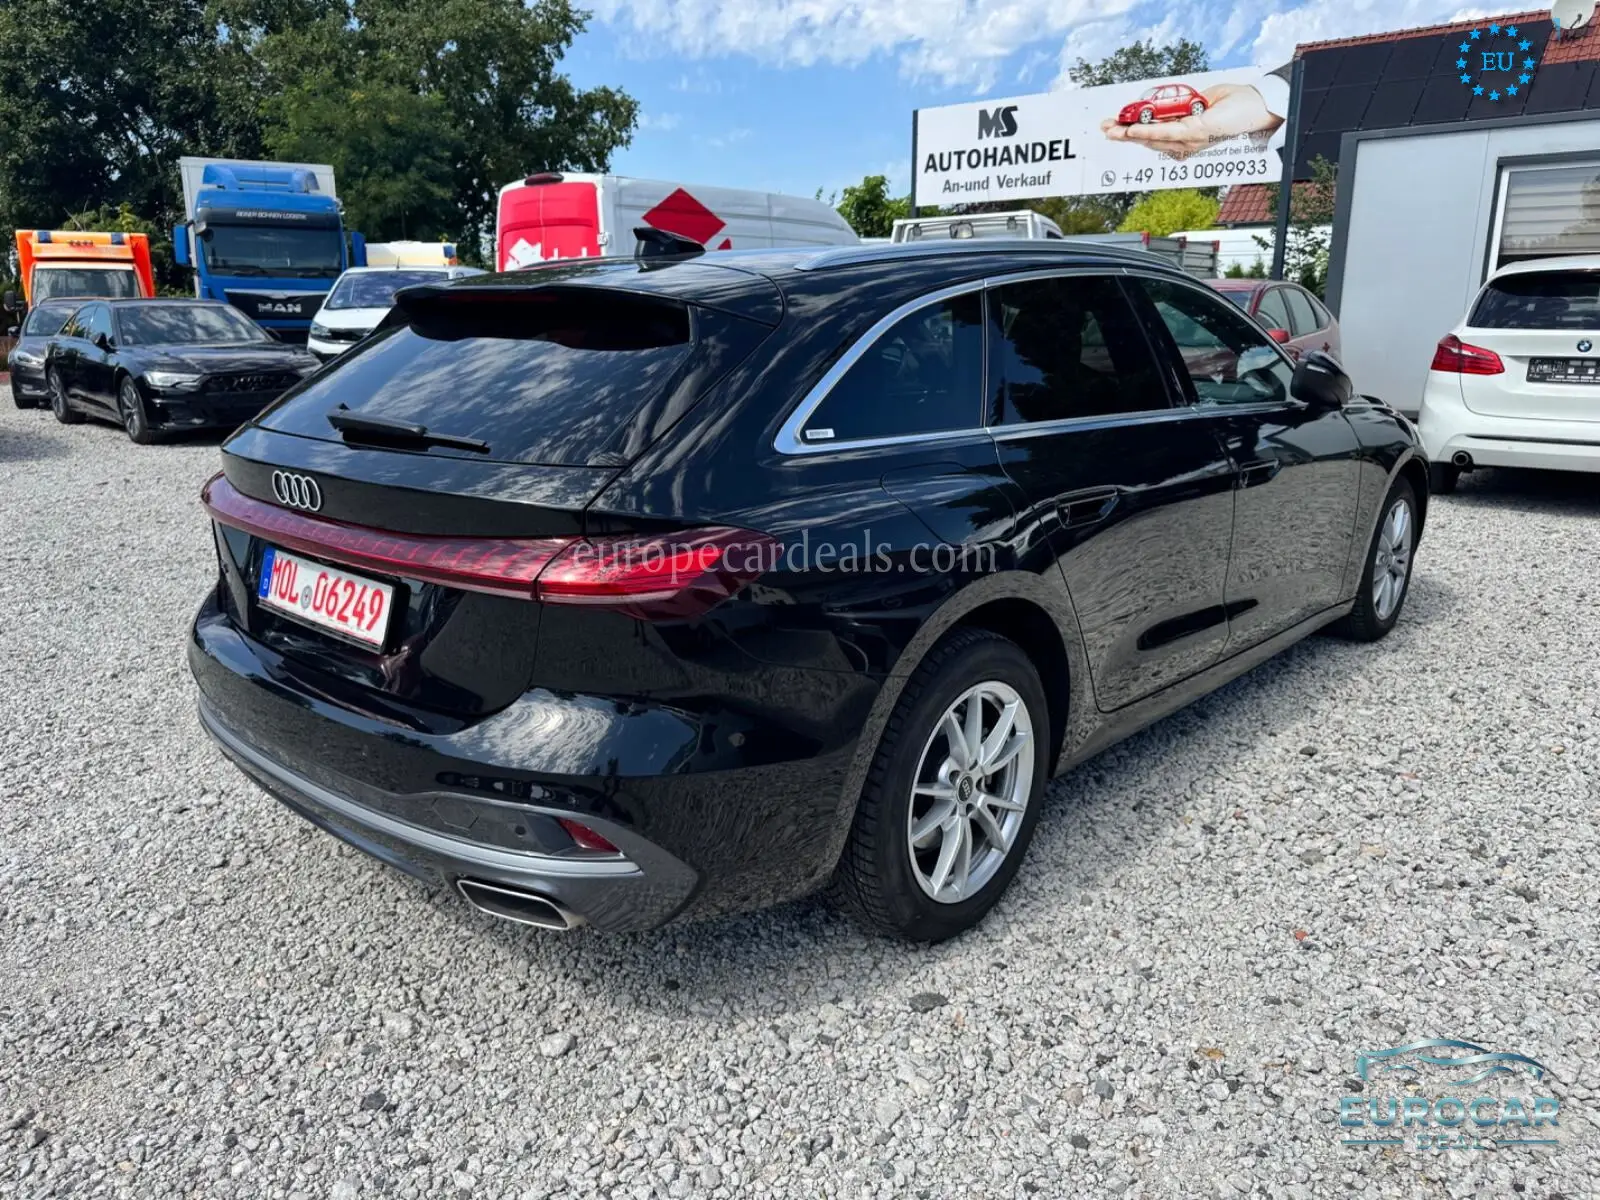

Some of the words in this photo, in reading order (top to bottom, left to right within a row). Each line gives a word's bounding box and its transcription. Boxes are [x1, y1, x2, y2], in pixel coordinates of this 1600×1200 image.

[977, 105, 1019, 140] MS
[1208, 132, 1240, 144] Berliner
[1229, 146, 1242, 156] bei
[1244, 144, 1268, 155] Berlin
[923, 138, 1077, 174] AUTOHANDEL
[942, 176, 990, 194] An-und
[996, 170, 1052, 189] Verkauf
[1122, 168, 1154, 185] +49
[1160, 165, 1189, 182] 163
[1194, 159, 1268, 180] 0099933
[257, 303, 302, 313] MAN
[270, 557, 299, 604] MOL
[312, 571, 384, 632] 06249
